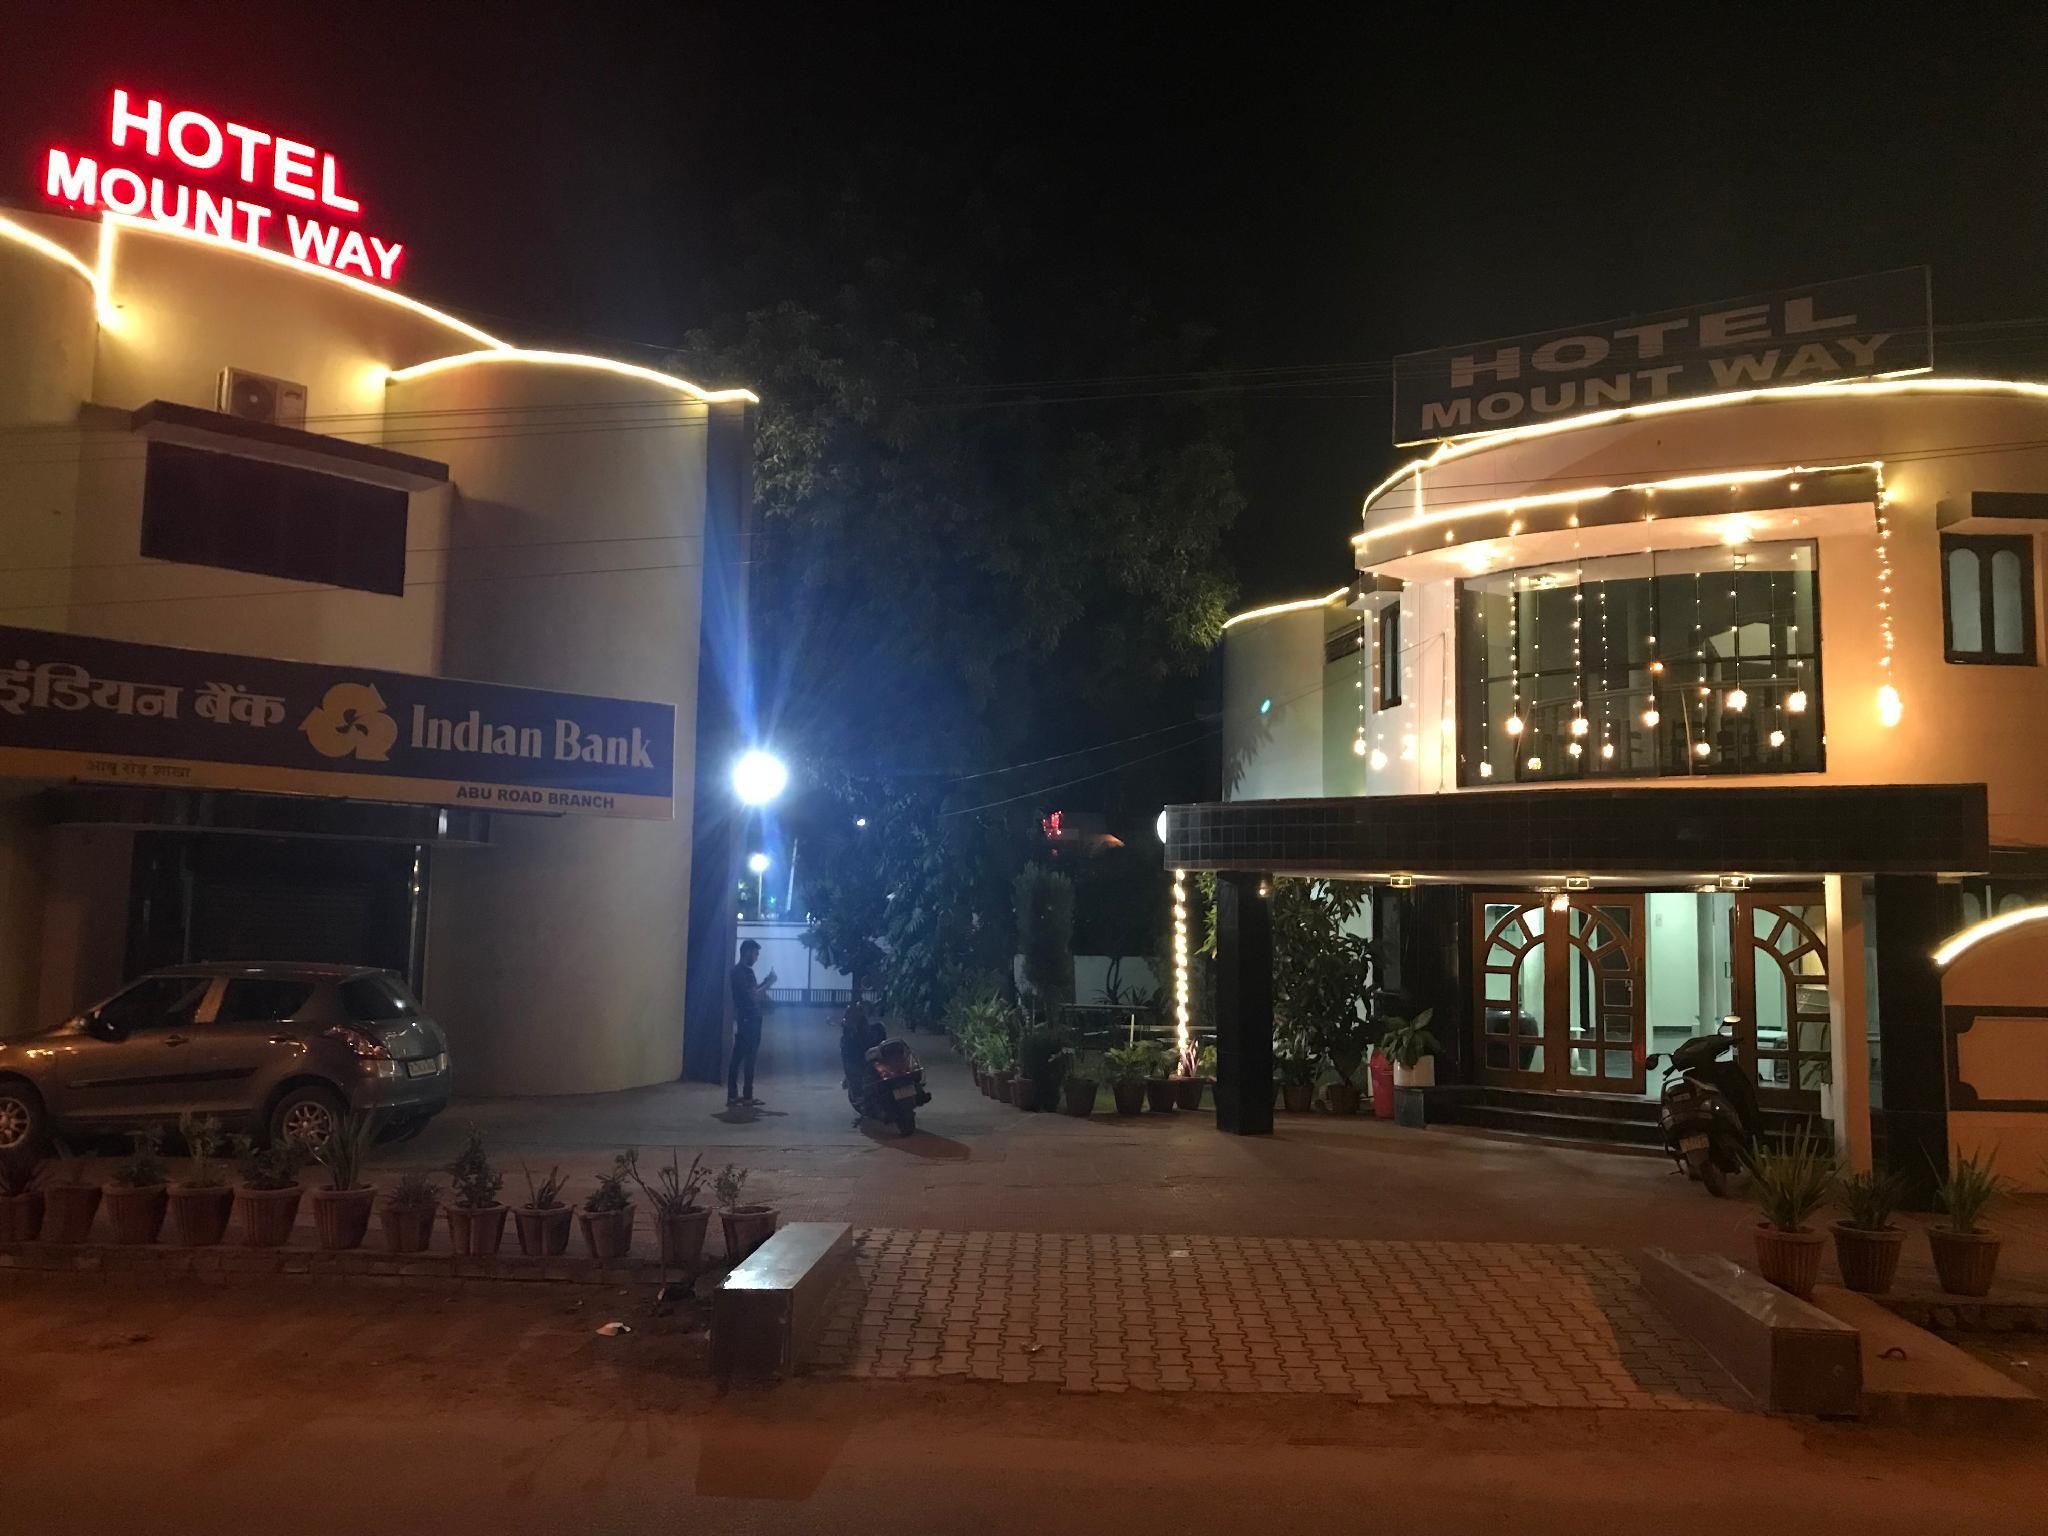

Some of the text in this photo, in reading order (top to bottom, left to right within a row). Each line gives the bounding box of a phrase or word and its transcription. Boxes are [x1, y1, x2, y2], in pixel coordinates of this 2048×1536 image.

[111, 88, 360, 213] HOTEL
[46, 148, 403, 280] MOUNT WAY
[1421, 333, 1894, 431] MOUNT WAY
[1450, 296, 1858, 389] HOTEL
[194, 680, 287, 728] बैंक
[410, 703, 655, 769] Indian Bank
[456, 784, 615, 809] ABU ROAD BRANCH
